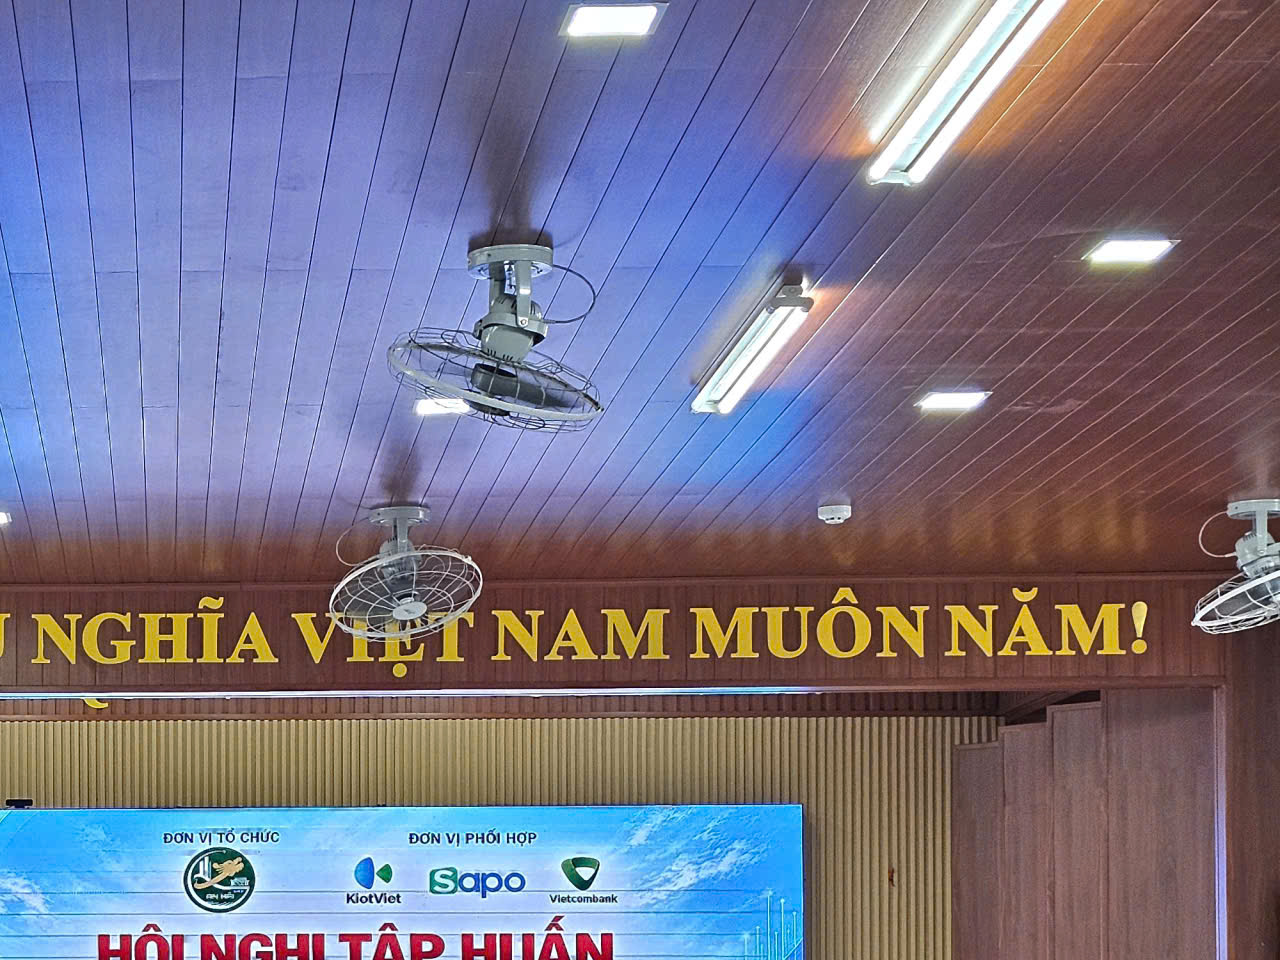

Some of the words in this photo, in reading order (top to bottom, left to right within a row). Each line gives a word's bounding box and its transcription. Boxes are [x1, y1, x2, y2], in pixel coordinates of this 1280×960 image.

[31, 596, 277, 665] NGHĨA
[492, 608, 669, 661] NAM
[691, 587, 929, 659] MUÔN
[946, 587, 1148, 657] NĂM!
[163, 831, 194, 844] ĐƠN
[199, 832, 213, 846] VỊ
[216, 827, 236, 844] TỔ
[240, 828, 280, 844] CHỨC
[408, 831, 441, 845] ĐƠN
[445, 832, 460, 847] VỊ
[465, 827, 501, 845] PHỐI
[506, 831, 537, 847] HỢP
[346, 892, 402, 904] KiotViet
[549, 893, 618, 904] Vietcombank
